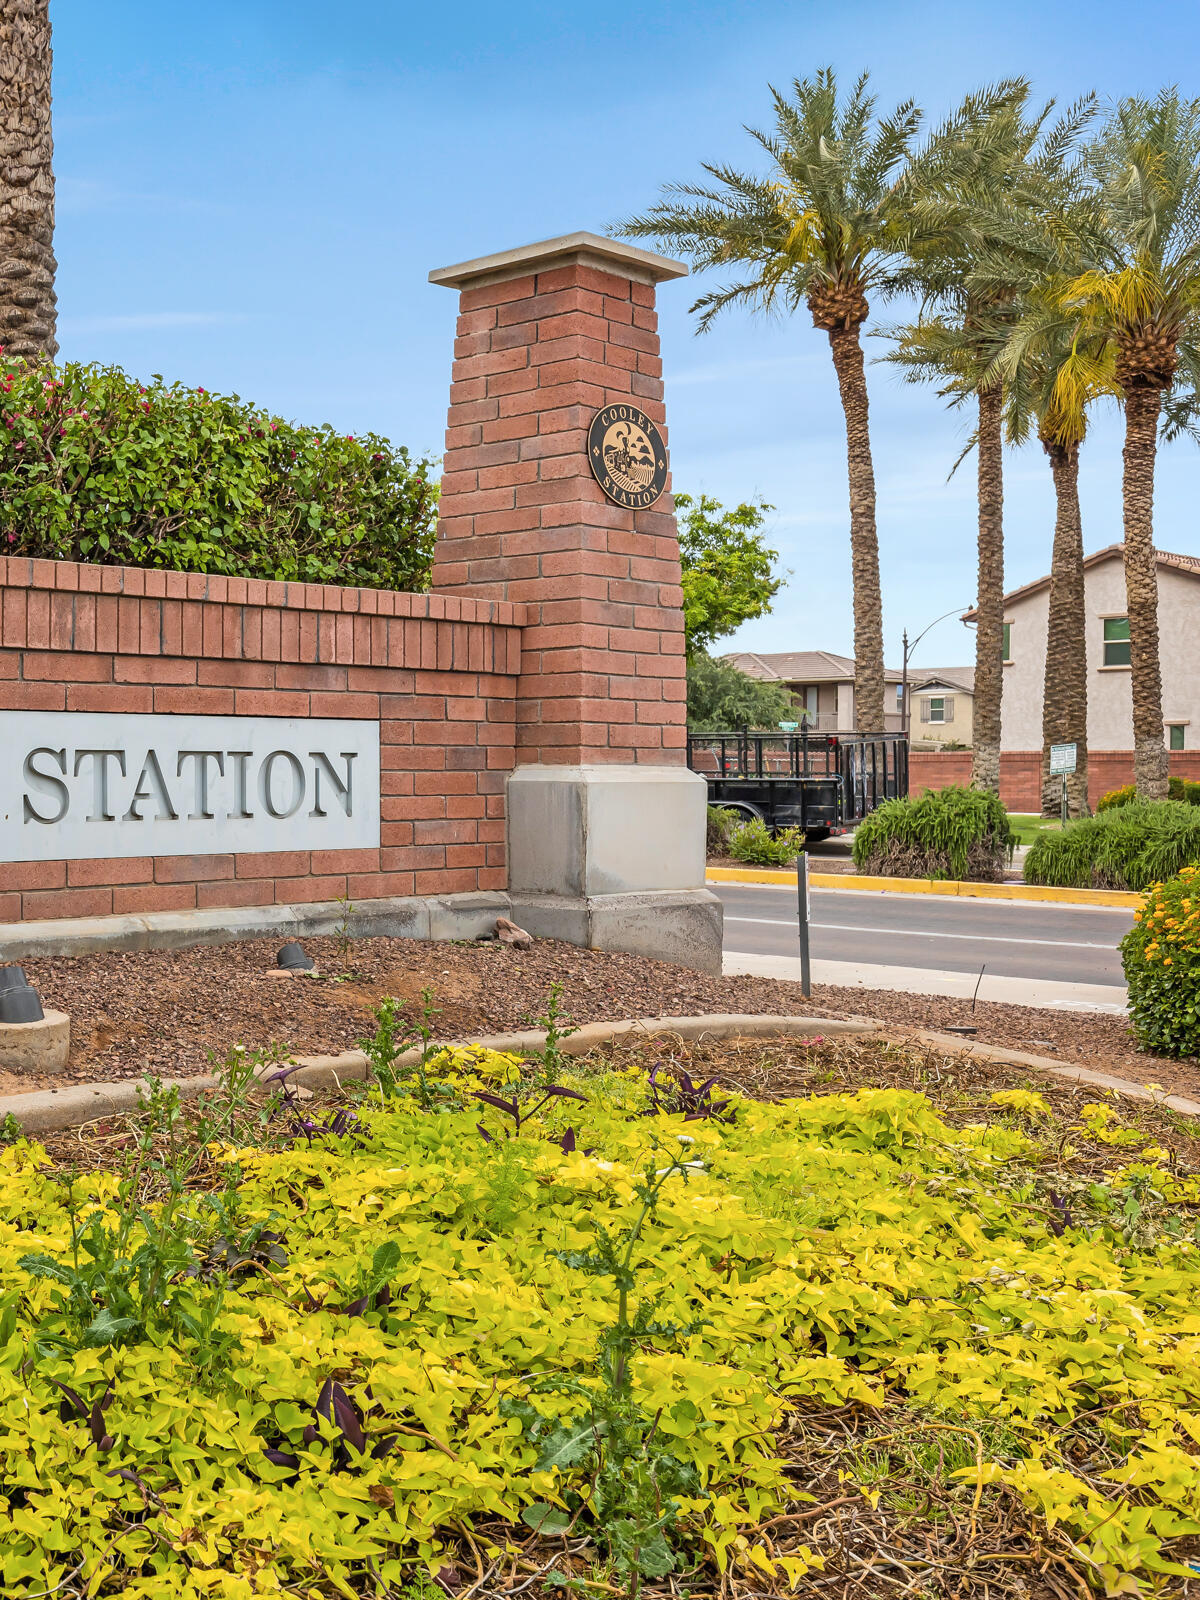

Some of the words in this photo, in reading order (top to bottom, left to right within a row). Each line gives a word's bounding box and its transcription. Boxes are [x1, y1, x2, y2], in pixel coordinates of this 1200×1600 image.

[601, 406, 654, 435] COOLEY
[603, 477, 658, 506] STATION
[22, 746, 360, 825] STATION
